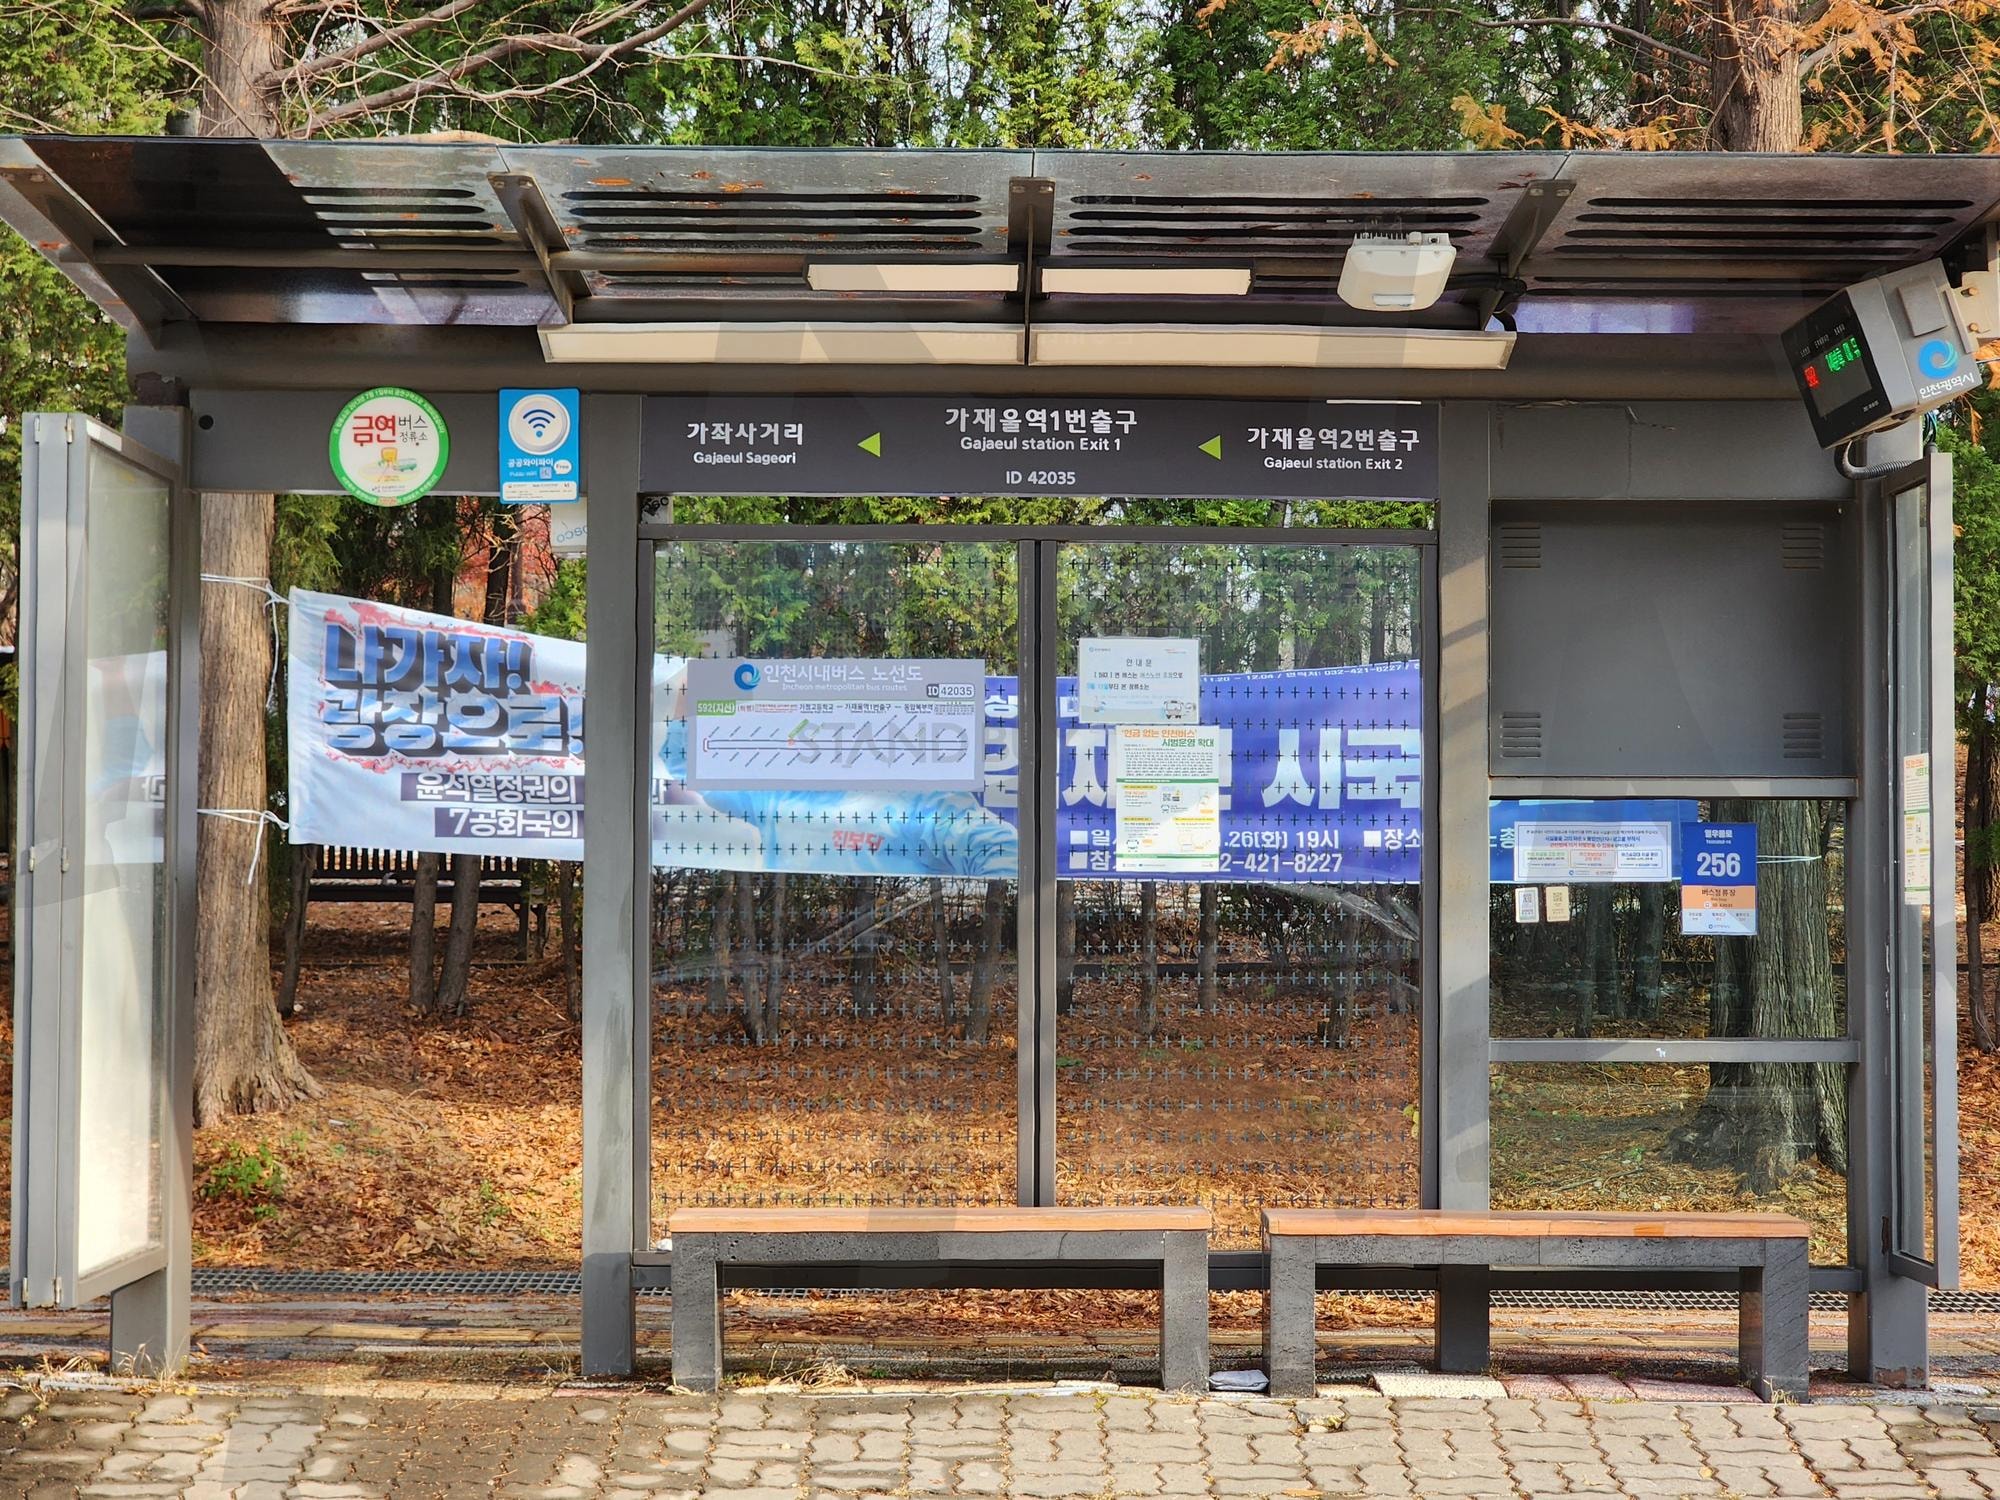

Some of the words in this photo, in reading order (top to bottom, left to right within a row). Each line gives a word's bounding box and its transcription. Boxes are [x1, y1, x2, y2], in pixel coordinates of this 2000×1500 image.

[1919, 372, 1975, 399] 인천광역시
[352, 415, 396, 443] 금연
[398, 414, 429, 430] 버스
[945, 407, 1137, 434] 가재울역1번출구
[399, 431, 428, 443] 정류소
[687, 422, 803, 446] 가좌사거리
[960, 437, 1017, 451] Gajaeul
[1022, 437, 1074, 450] station
[1079, 438, 1109, 451] Exit
[1115, 439, 1121, 451] 1
[1247, 427, 1420, 451] 가재울역2번출구
[508, 457, 554, 468] 공공와이파이
[693, 452, 743, 465] Gajaeul
[746, 452, 796, 465] Sageori
[1264, 457, 1313, 470] Gajaeul
[1316, 458, 1361, 469] station
[1365, 458, 1391, 470] Exit
[1394, 459, 1403, 470] 2
[1006, 471, 1022, 484] ID
[1027, 471, 1076, 485] 42035
[324, 623, 530, 690] 나가자!
[764, 664, 866, 684] 인천시내버스
[872, 665, 924, 683] 노선도
[783, 683, 812, 691] Incheon
[815, 683, 864, 692] metropolitan
[928, 686, 939, 695] ID
[940, 686, 973, 696] 42035
[320, 689, 584, 755] 광장으로!
[1162, 739, 1196, 747] 시범운영
[1262, 728, 1420, 809] 시국
[416, 773, 578, 805] 윤석열정권의
[449, 809, 578, 839] 7공화국의
[831, 830, 886, 852] 진보당
[1296, 831, 1340, 849] 19시
[1384, 828, 1421, 850] 장소
[1696, 852, 1741, 877] 256
[1701, 888, 1736, 897] 버스정류장
